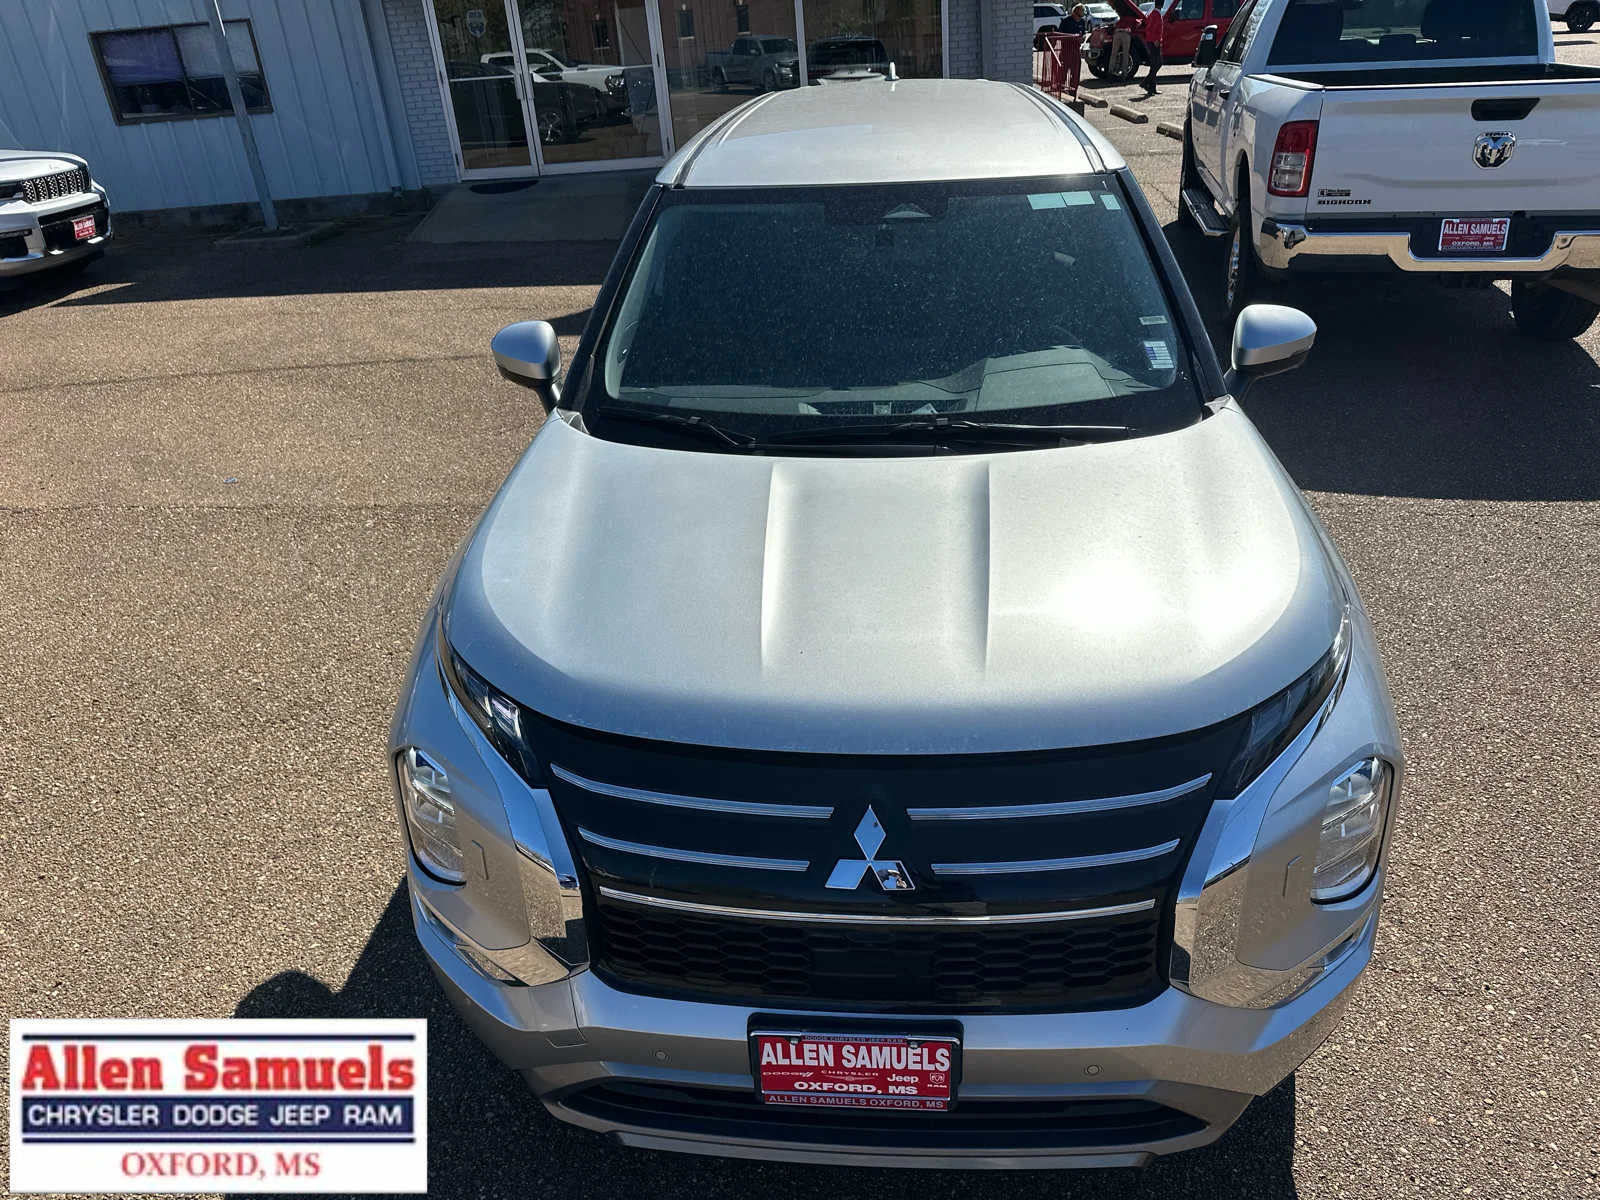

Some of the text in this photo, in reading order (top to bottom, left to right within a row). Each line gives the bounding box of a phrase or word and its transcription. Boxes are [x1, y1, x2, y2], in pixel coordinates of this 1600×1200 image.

[1443, 223, 1507, 234] ALLEN SAMUELS
[761, 1042, 950, 1072] ALLEN SAMUELS
[887, 1073, 919, 1083] Jeep
[794, 1081, 918, 1095] OXFORD, MS
[769, 1095, 944, 1108] ALLEN SAMUELS OXFORD, MS
